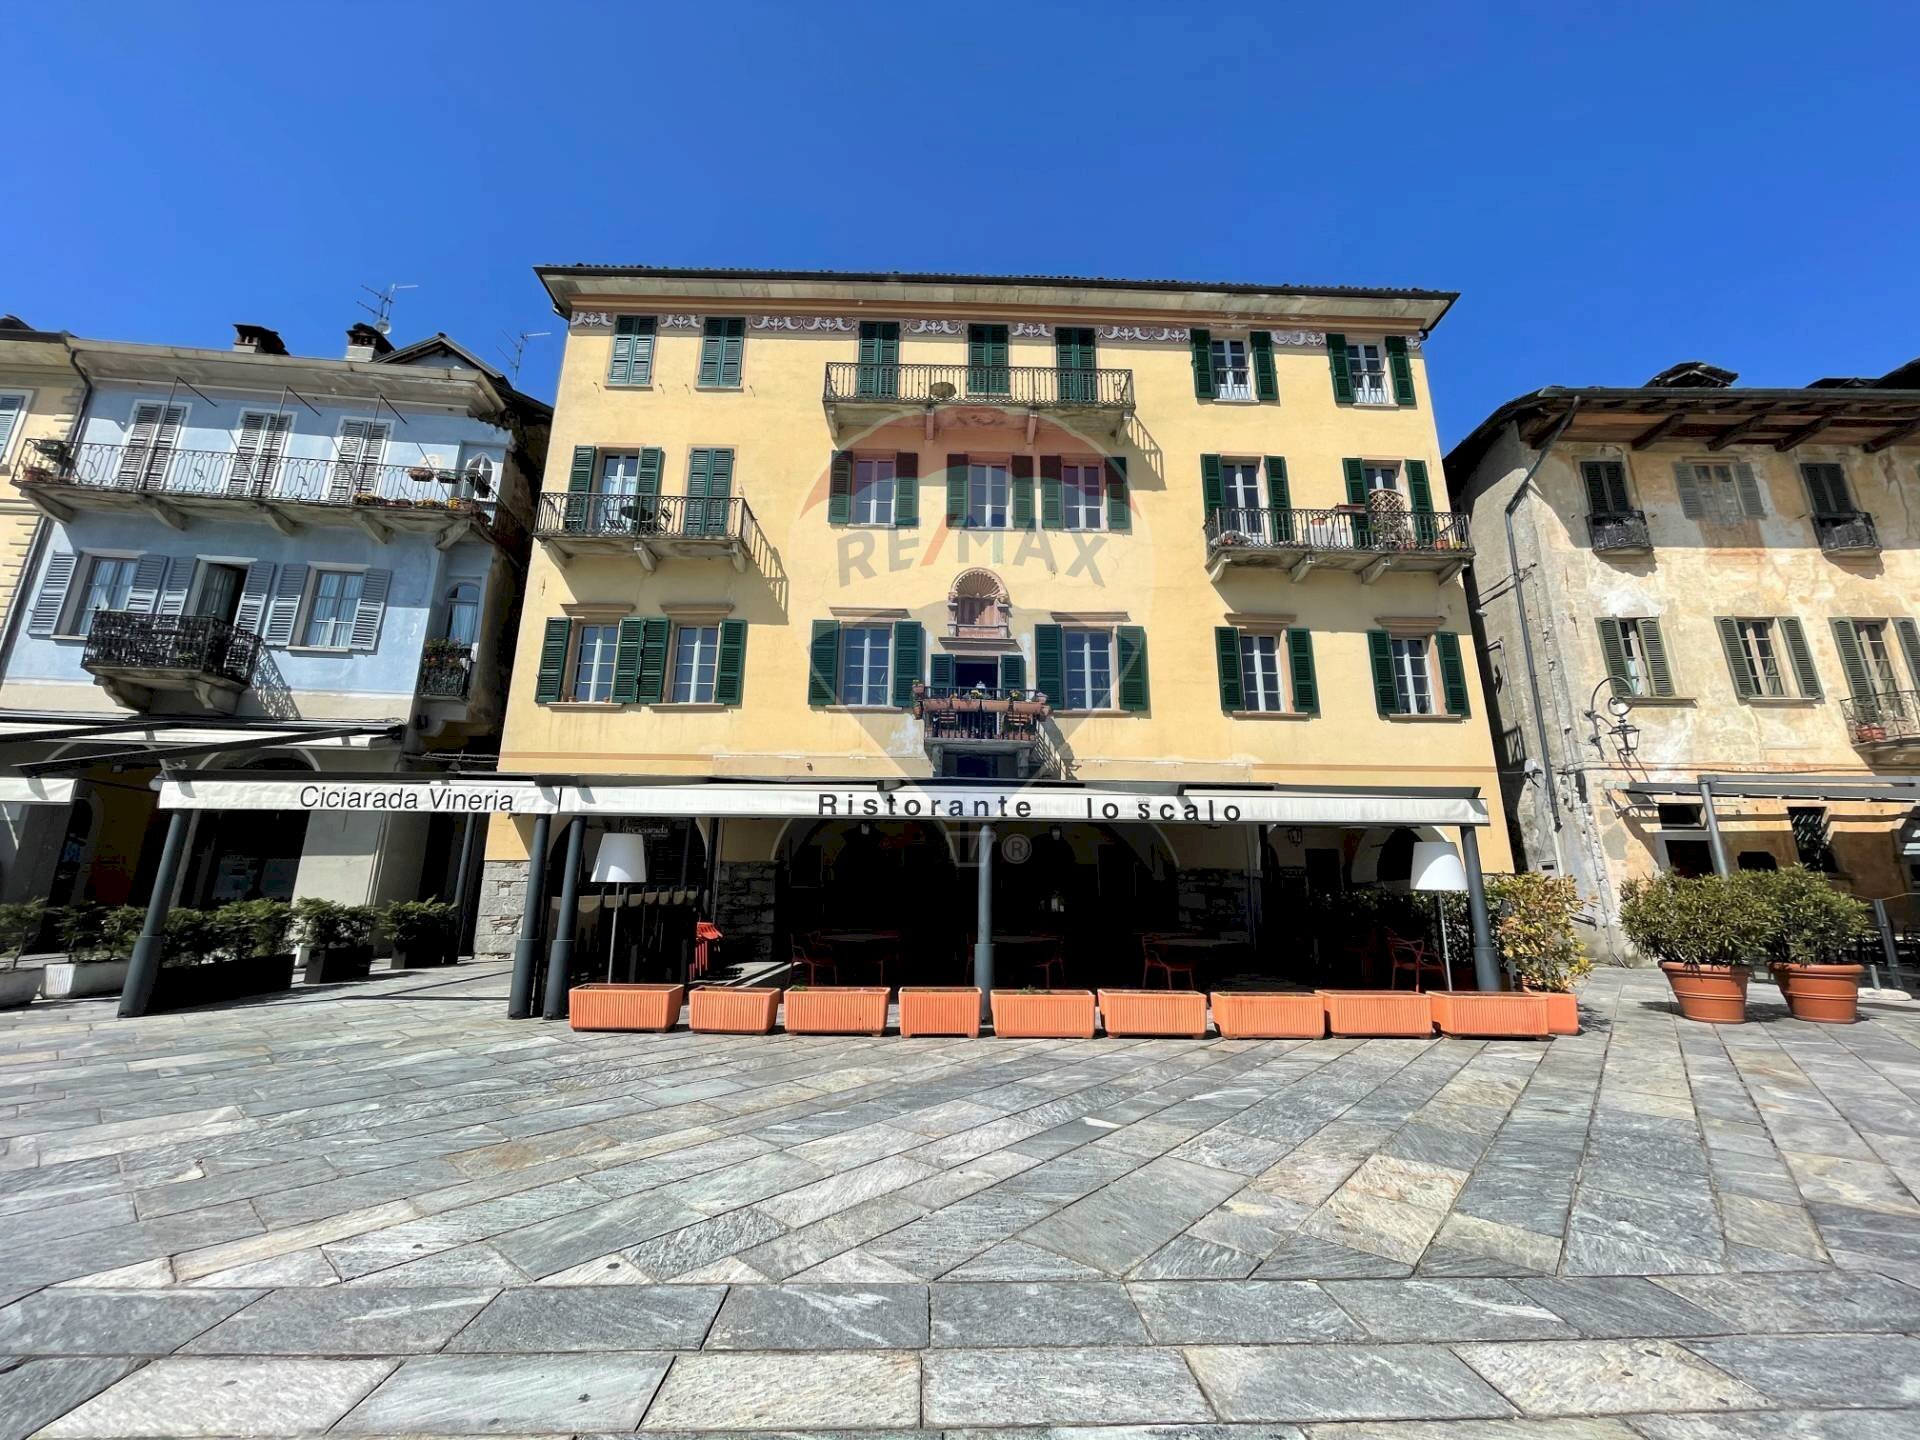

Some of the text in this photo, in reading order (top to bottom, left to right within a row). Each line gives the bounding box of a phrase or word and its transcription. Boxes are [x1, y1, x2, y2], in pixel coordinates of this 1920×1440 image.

[300, 785, 514, 811] Ciciarada Vineria
[817, 793, 1032, 818] Ristorante
[1137, 800, 1241, 822] scalo
